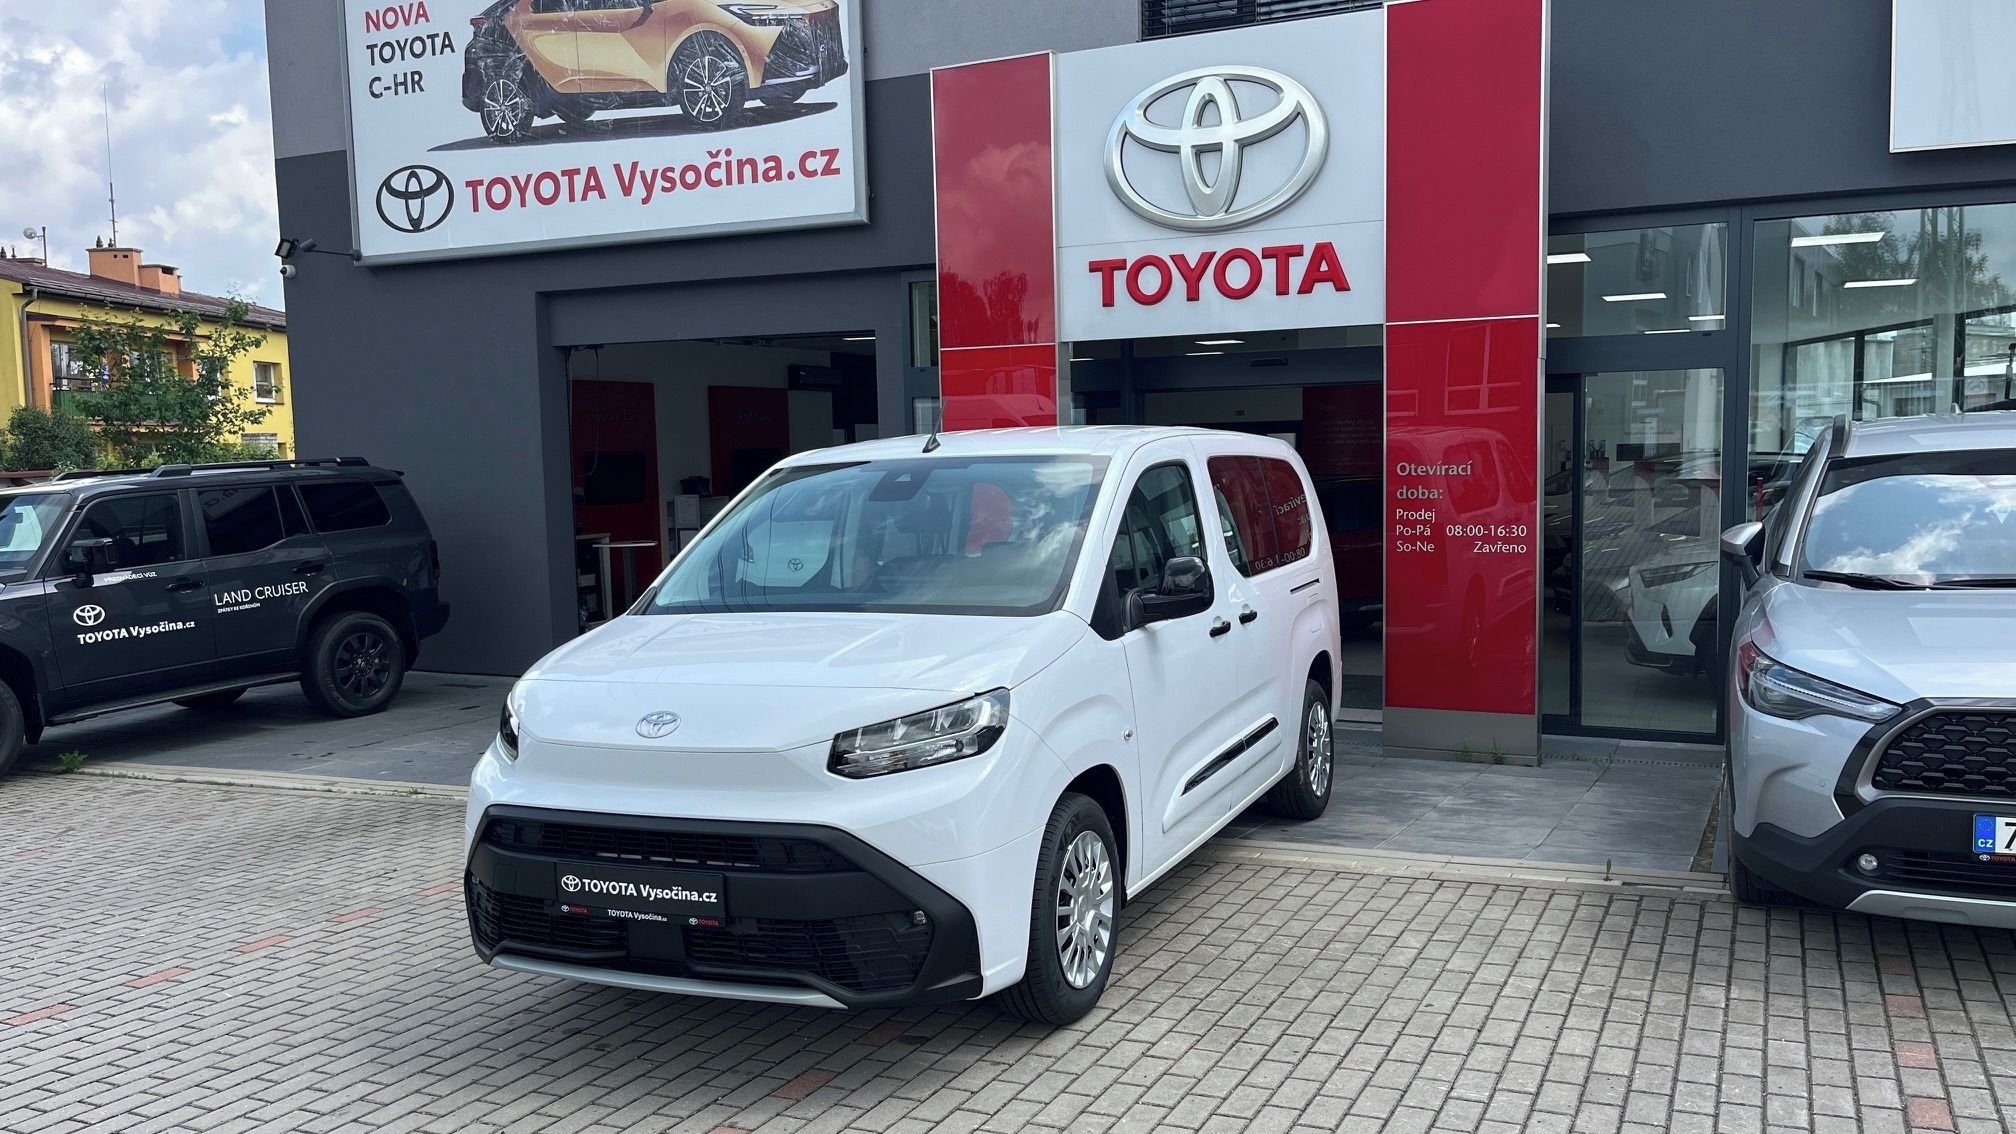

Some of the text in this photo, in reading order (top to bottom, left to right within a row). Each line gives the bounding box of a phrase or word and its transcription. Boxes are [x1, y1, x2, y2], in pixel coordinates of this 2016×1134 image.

[365, 1, 430, 33] NOVA
[366, 31, 456, 66] TOYOTA
[369, 70, 425, 99] C-HR
[465, 147, 841, 213] TOYOTA Vysočina.cz
[1089, 241, 1351, 308] TOYOTA
[1396, 460, 1473, 476] Otevírací
[1396, 485, 1443, 499] doba:
[1396, 508, 1436, 523] Prodej
[1396, 524, 1527, 537] Po-Pá 08:00-16:30
[1396, 540, 1527, 553] So-Ne Zavřeno
[214, 581, 309, 606] LAND CRUISER
[77, 620, 196, 645] TOYOTA Vysočina.cz
[1977, 838, 1993, 848] CZ
[582, 878, 718, 903] TOYOTA Vysočina.cz
[607, 909, 633, 918] TOYOTA
